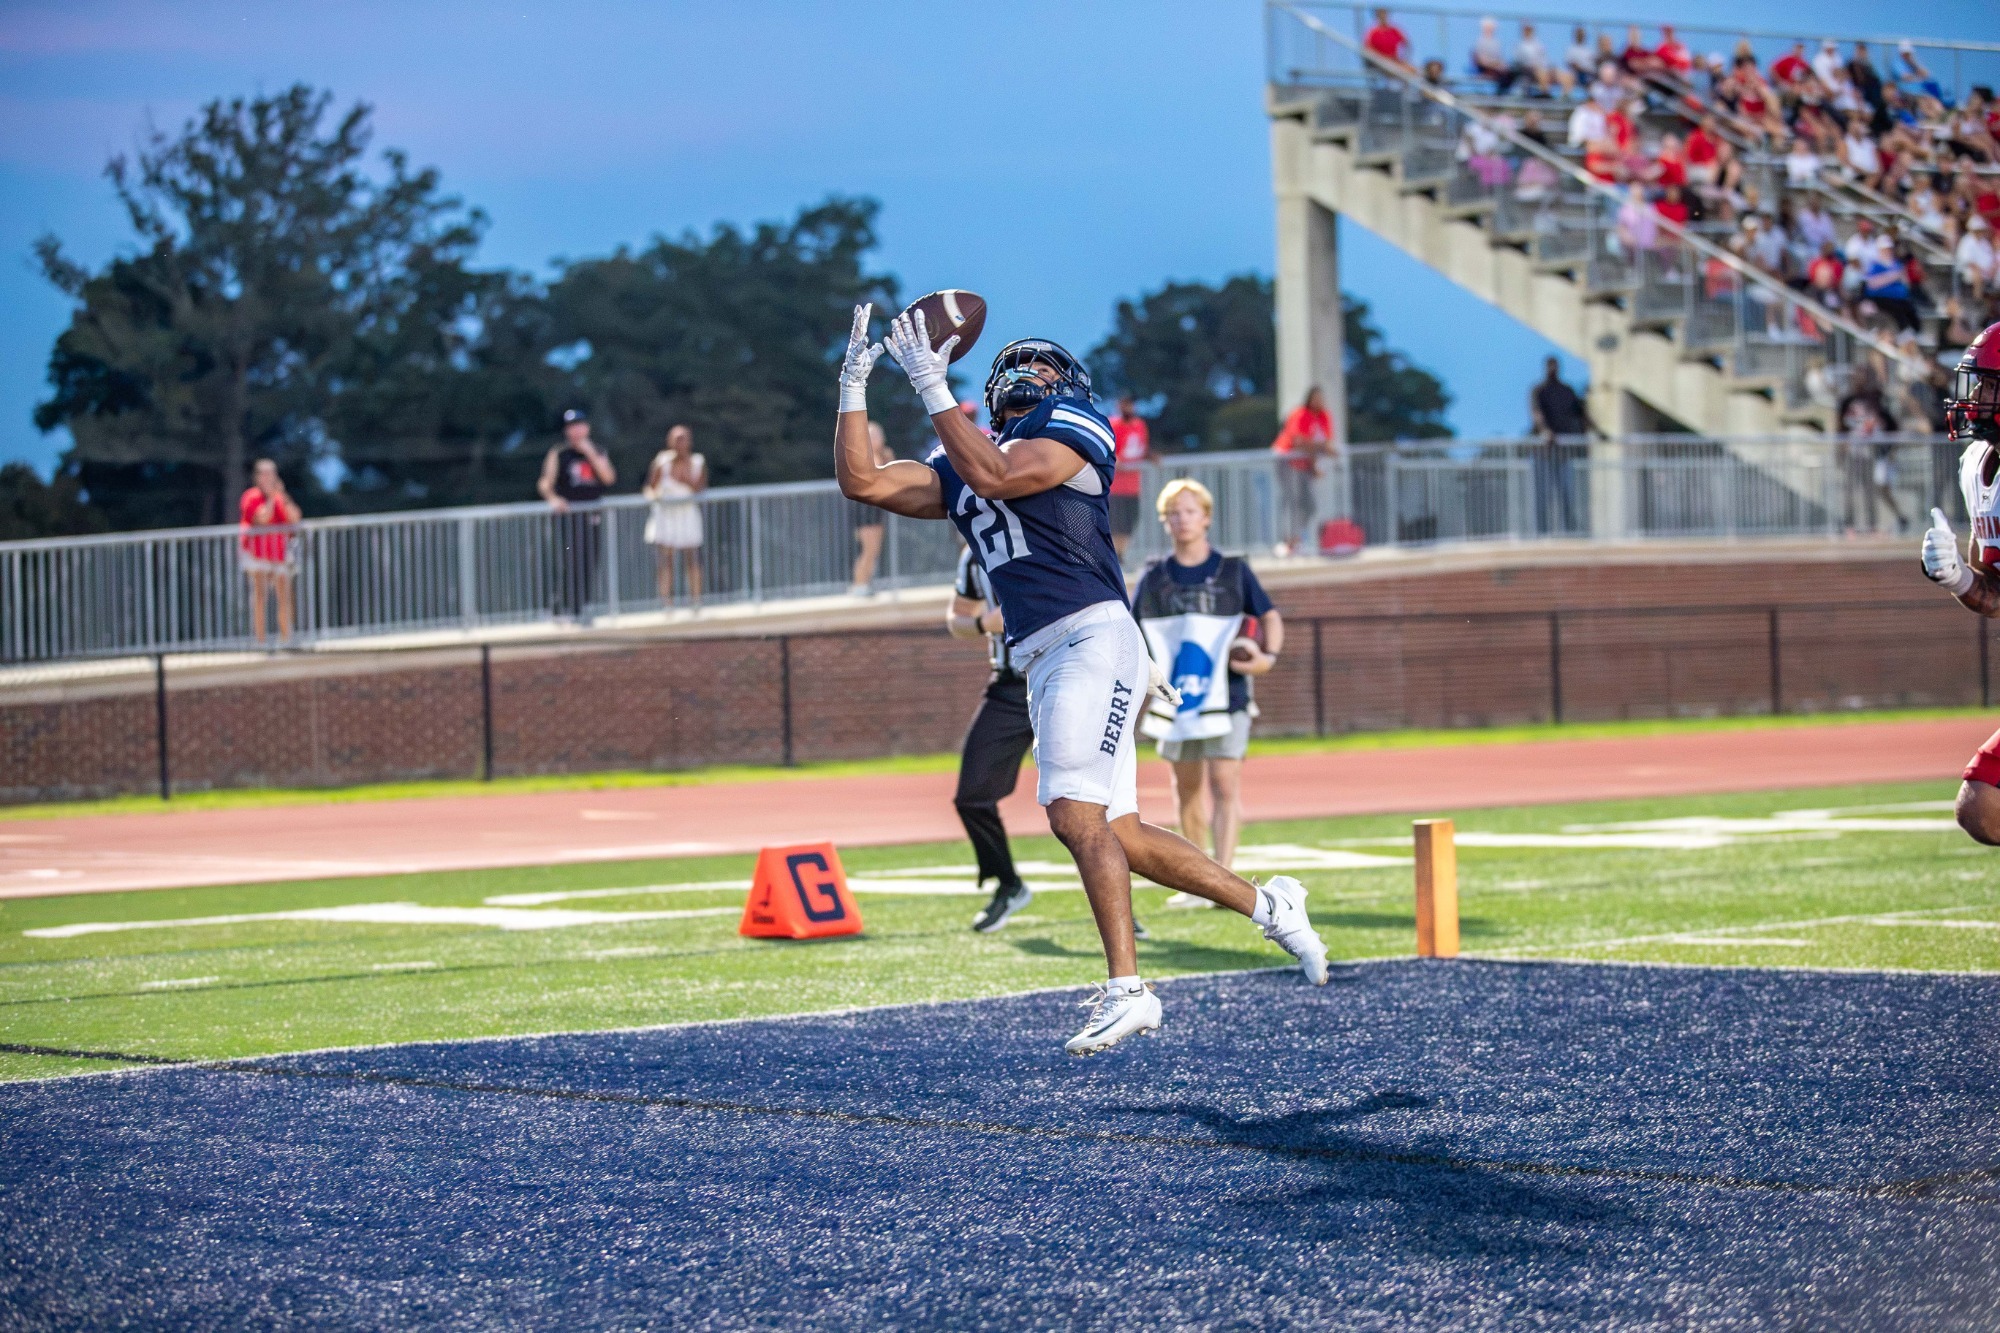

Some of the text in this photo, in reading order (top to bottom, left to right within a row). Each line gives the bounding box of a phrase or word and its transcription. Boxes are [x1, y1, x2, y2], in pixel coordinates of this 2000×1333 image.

[957, 484, 1032, 573] 21
[1100, 680, 1132, 757] BERRY
[786, 852, 845, 922] G
